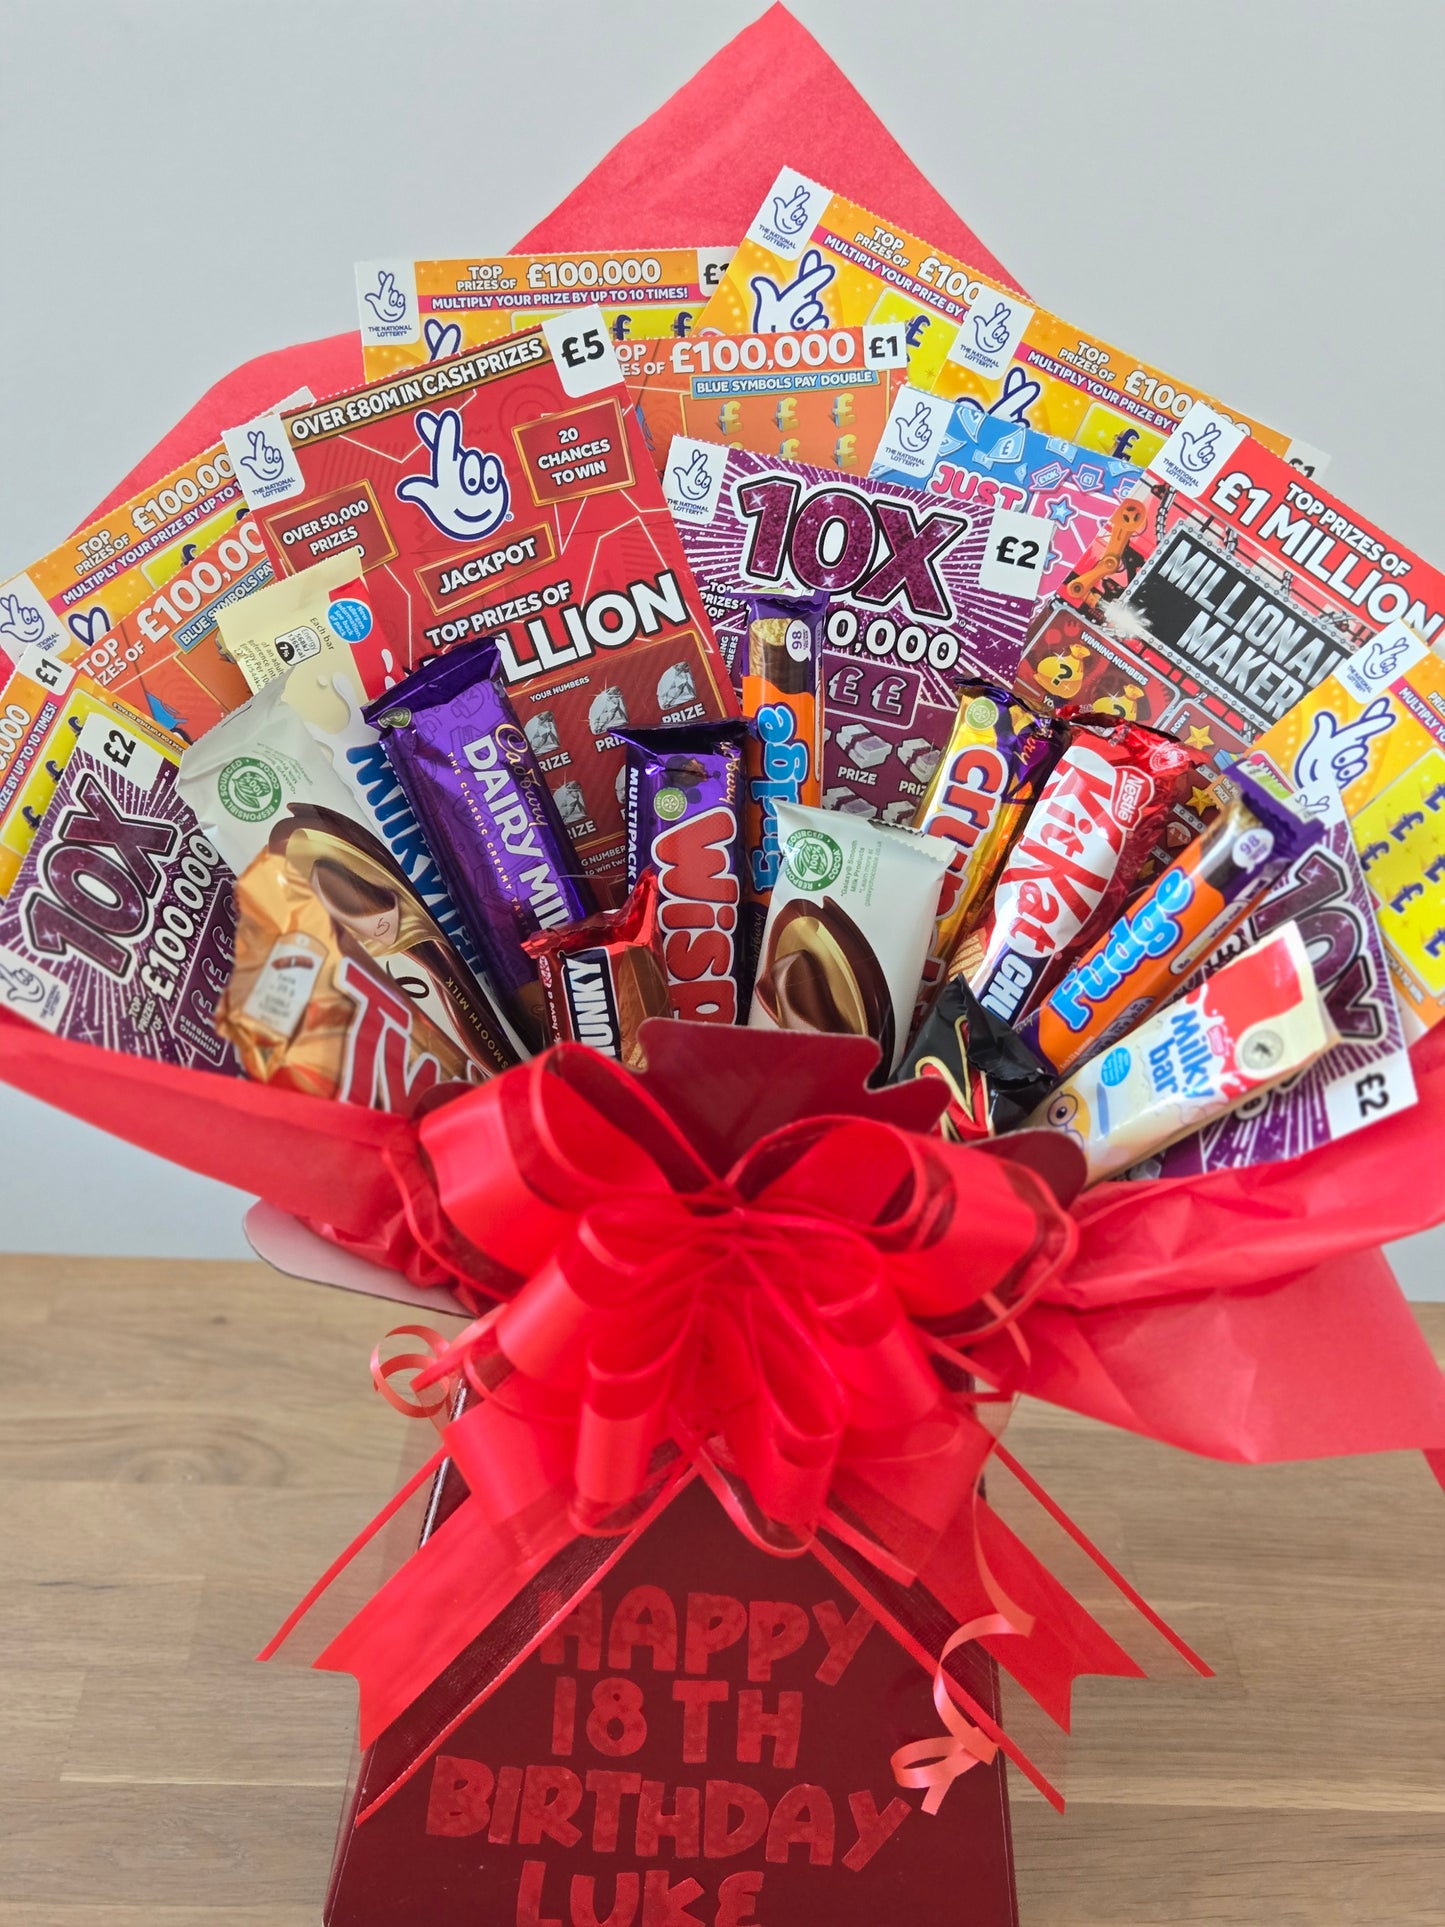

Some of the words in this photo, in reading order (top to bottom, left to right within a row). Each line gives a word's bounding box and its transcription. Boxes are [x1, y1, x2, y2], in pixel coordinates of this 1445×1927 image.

[758, 224, 769, 235] THE
[768, 229, 797, 250] NATIONAL
[854, 232, 893, 260] PRIZES
[892, 252, 910, 268] OF
[873, 225, 905, 251] TOP
[456, 278, 500, 291] PRIZES
[500, 277, 517, 289] OF
[468, 264, 504, 281] TOP
[526, 258, 662, 289] £100,000
[824, 234, 881, 272] MULTIPLY
[879, 263, 913, 290] YOUR
[912, 280, 946, 308] PRIZE
[945, 298, 964, 317] BY
[431, 295, 494, 311] MULTIPLY
[495, 293, 533, 307] YOUR
[533, 292, 570, 306] PRIZE
[571, 291, 589, 304] BY
[590, 290, 608, 303] UP
[608, 289, 627, 302] TO
[628, 289, 645, 301] 10
[646, 287, 688, 301] TIMES!
[381, 324, 412, 333] NATIONAL
[560, 329, 605, 368] £5
[669, 331, 856, 375] £100,000
[868, 335, 899, 359] £1
[959, 343, 972, 356] THE
[971, 349, 999, 369] NATIONAL
[1058, 347, 1099, 375] PRIZES
[1098, 367, 1116, 383] OF
[1077, 339, 1111, 366] TOP
[643, 360, 666, 375] OF
[696, 379, 730, 395] BLUE
[731, 375, 793, 393] SYMBOLS
[794, 373, 819, 389] PAY
[820, 370, 873, 387] DOUBLE
[291, 406, 347, 441] OVER
[346, 391, 401, 423] £80M
[400, 381, 423, 406] IN
[422, 357, 479, 397] CASH
[476, 337, 544, 378] PRIZES
[1027, 350, 1086, 388] MULTIPLY
[1085, 378, 1121, 405] YOUR
[1118, 396, 1155, 424] PRIZE
[1153, 413, 1172, 430] BY
[557, 426, 579, 443] 20
[536, 438, 611, 470] CHANCES
[884, 446, 896, 456] THE
[896, 449, 926, 467] NATIONAL
[1162, 456, 1176, 470] THE
[1175, 463, 1200, 488] NATIONAL
[252, 487, 265, 496] THE
[264, 476, 296, 494] NATIONAL
[551, 469, 575, 487] TO
[574, 459, 608, 483] WIN
[930, 465, 1024, 512] JUST
[667, 497, 680, 506] THE
[680, 500, 710, 514] NATIONAL
[1210, 471, 1272, 527] £1
[282, 520, 322, 545] OVER
[320, 499, 369, 530] 50,000
[1288, 480, 1323, 517] TOP
[1320, 506, 1383, 560] PRIZES
[1380, 545, 1413, 579] OF
[62, 561, 119, 606] MULTIPLY
[116, 538, 153, 569] YOUR
[150, 519, 186, 549] PRIZE
[182, 509, 200, 526] BY
[199, 497, 217, 515] UP
[214, 487, 235, 504] TO
[74, 545, 116, 576] PRIZES
[113, 532, 131, 552] OF
[77, 529, 112, 559] TOP
[309, 525, 359, 556] PRIZES
[736, 474, 968, 622] 10X
[995, 535, 1040, 570] £2
[438, 537, 536, 595] JACKPOT
[1257, 502, 1444, 644] MILLION
[179, 614, 210, 647] BLUE
[207, 577, 258, 624] SYMBOLS
[356, 605, 368, 621] New
[425, 619, 469, 648] TOP
[469, 592, 542, 633] PRIZES
[541, 581, 571, 604] OF
[699, 591, 739, 610] PRIZES
[707, 606, 726, 619] OF
[1158, 537, 1348, 687] MILLIONAI
[300, 627, 317, 651] Energy
[310, 616, 325, 635] Each
[323, 634, 335, 651] bar
[497, 571, 688, 684] LLION
[790, 628, 804, 653] 98
[827, 610, 960, 671] 0,000
[77, 638, 119, 678] TOP
[124, 640, 145, 662] OF
[279, 643, 290, 658] 7%
[1080, 631, 1114, 659] WINNING
[1111, 655, 1149, 686] NUMBERS
[1176, 608, 1305, 720] MAKER
[35, 658, 62, 687] £1
[529, 688, 552, 702] YOUR
[552, 675, 590, 695] NUMBERS
[1170, 715, 1186, 735] ROW
[1398, 685, 1439, 730] MULTIPLY
[7, 771, 20, 789] BY
[15, 758, 27, 776] UP
[23, 744, 36, 761] TO
[30, 731, 42, 749] 10
[40, 701, 58, 734] TIMES!
[103, 729, 137, 768] £2
[219, 759, 243, 797] SOURCED
[243, 771, 263, 796] 100%
[495, 723, 549, 829] Cadbury
[837, 765, 878, 787] PRIZE
[221, 797, 276, 822] RESPONSIBLY
[447, 751, 462, 776] THE
[460, 781, 489, 837] CLASSIC
[486, 841, 513, 891] CREAMY
[628, 767, 639, 878] MULTIPACK
[462, 734, 545, 858] DAIRY
[518, 862, 571, 931] MIL
[1240, 834, 1261, 855] 98
[595, 861, 612, 874] win
[808, 845, 822, 871] 100%
[999, 757, 1127, 956] KitKat
[24, 772, 179, 979] 10X
[141, 834, 220, 1002] £100,000
[651, 806, 741, 1026] Wisp
[1050, 868, 1194, 1031] Fudge
[128, 995, 143, 1018] TOP
[445, 976, 470, 1011] MILK
[137, 998, 157, 1033] PRIZES
[152, 1014, 164, 1032] OF
[180, 1013, 222, 1051] NUMBERS
[179, 1024, 217, 1057] WINNING
[468, 1011, 509, 1070] SMOOTH
[1170, 1009, 1215, 1099] Milky
[1148, 1036, 1179, 1094] bar
[1355, 1072, 1391, 1117] £2
[538, 1583, 876, 1687] HAPPY
[425, 1754, 912, 1873] BIRTHDAY
[515, 1860, 766, 1927] LUKE
